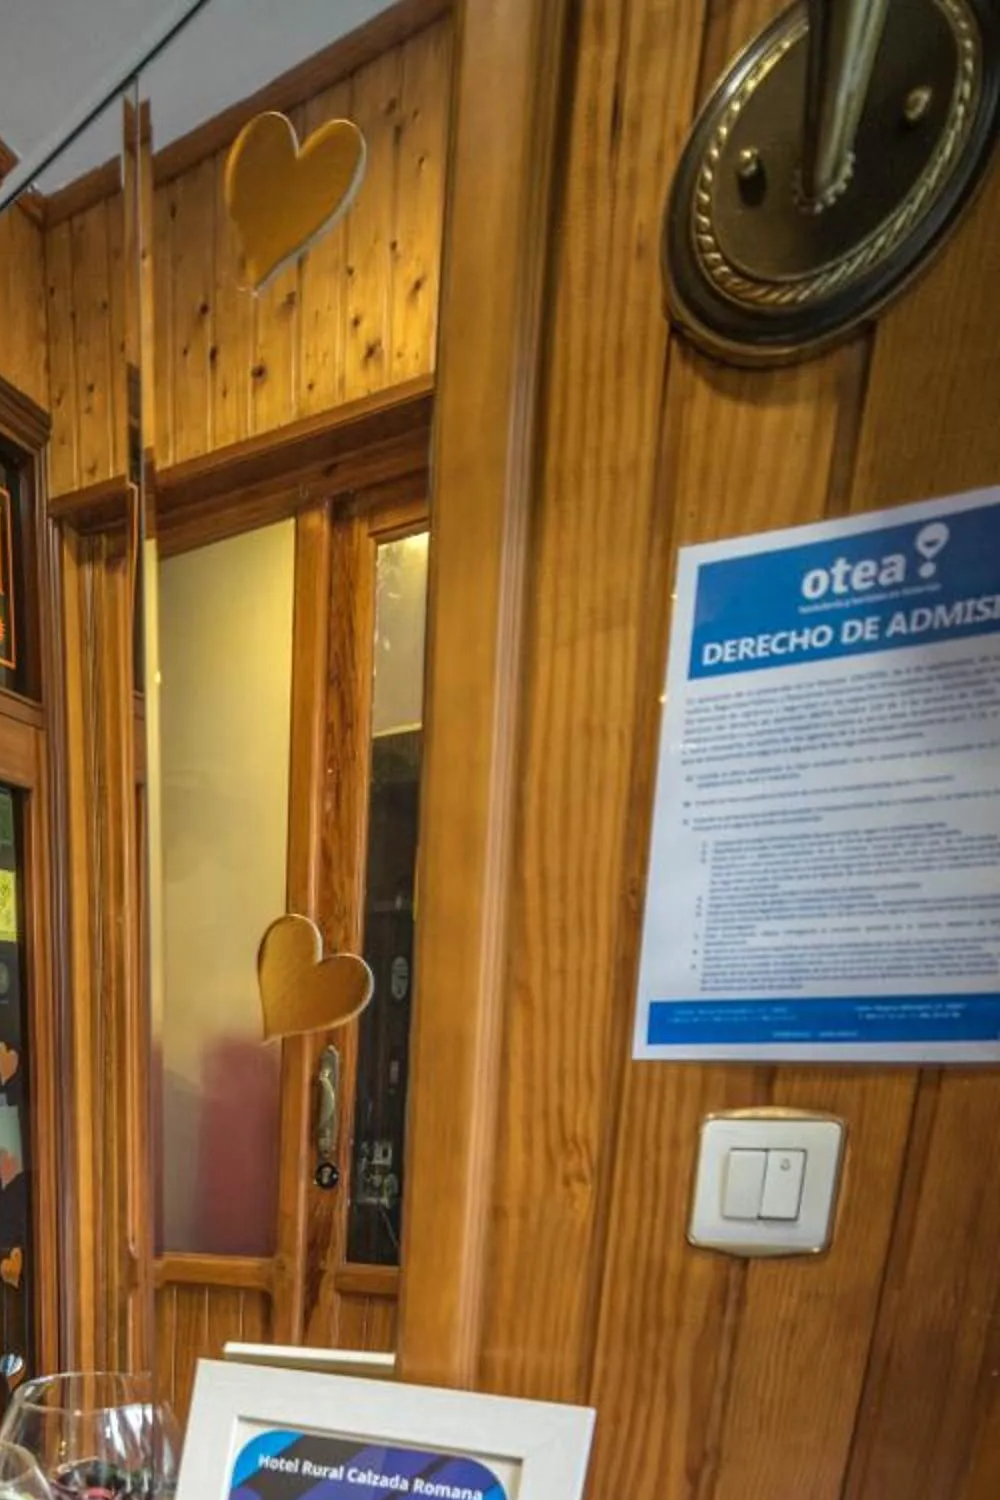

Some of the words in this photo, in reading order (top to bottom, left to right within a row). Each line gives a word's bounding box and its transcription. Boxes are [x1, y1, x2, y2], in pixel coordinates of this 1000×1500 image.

[802, 553, 906, 600] otea
[702, 625, 834, 667] DERECHO
[840, 616, 881, 645] DE
[258, 1453, 300, 1473] Hotel
[302, 1460, 345, 1481] Rural
[348, 1466, 410, 1492] Calzada
